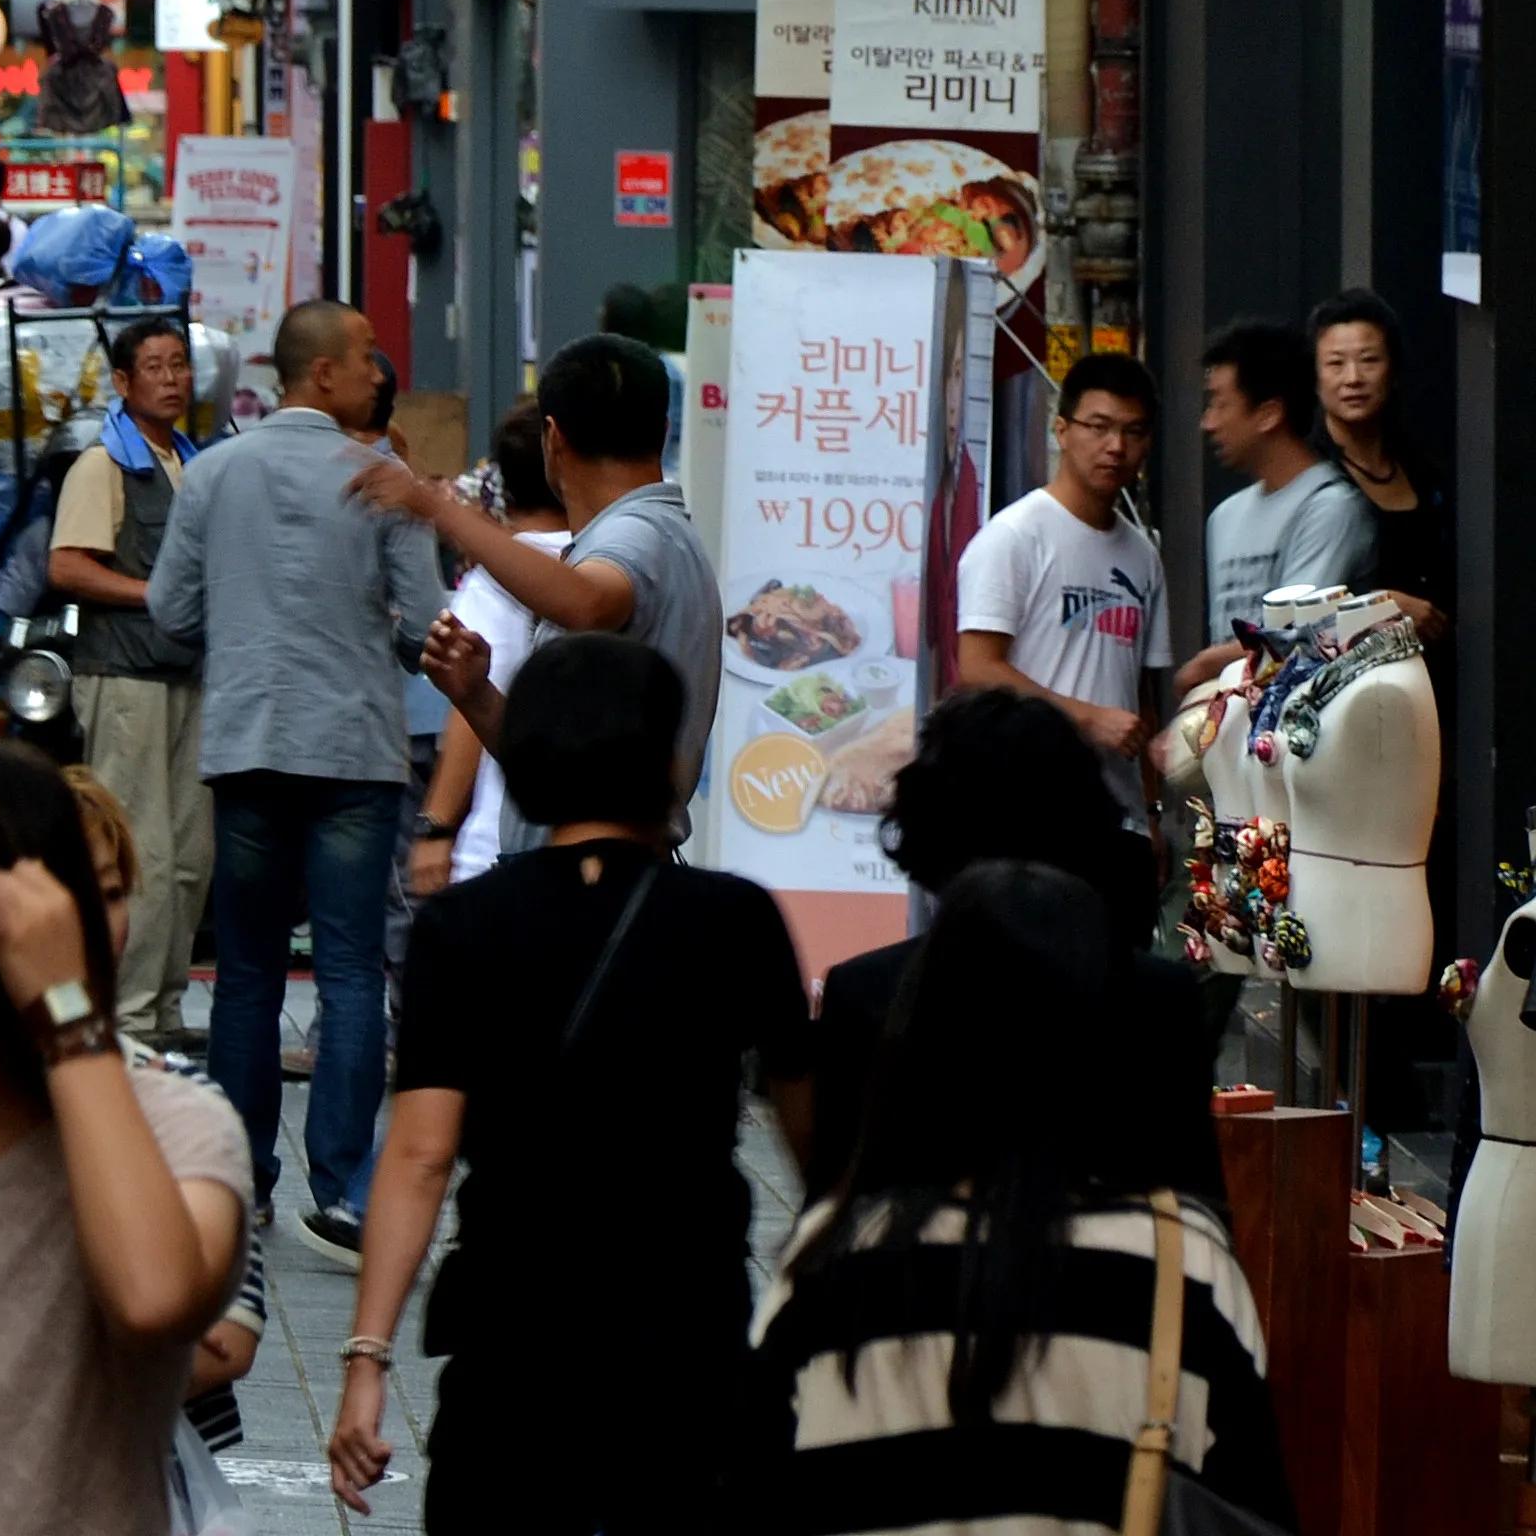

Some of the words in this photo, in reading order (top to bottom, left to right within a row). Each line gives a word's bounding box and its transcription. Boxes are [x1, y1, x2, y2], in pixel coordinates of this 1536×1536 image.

[851, 47, 935, 69] 이탈리안
[944, 49, 1006, 70] 파스타
[905, 74, 1016, 114] 리미니
[801, 336, 924, 388] 리미니
[756, 386, 861, 453] 커플
